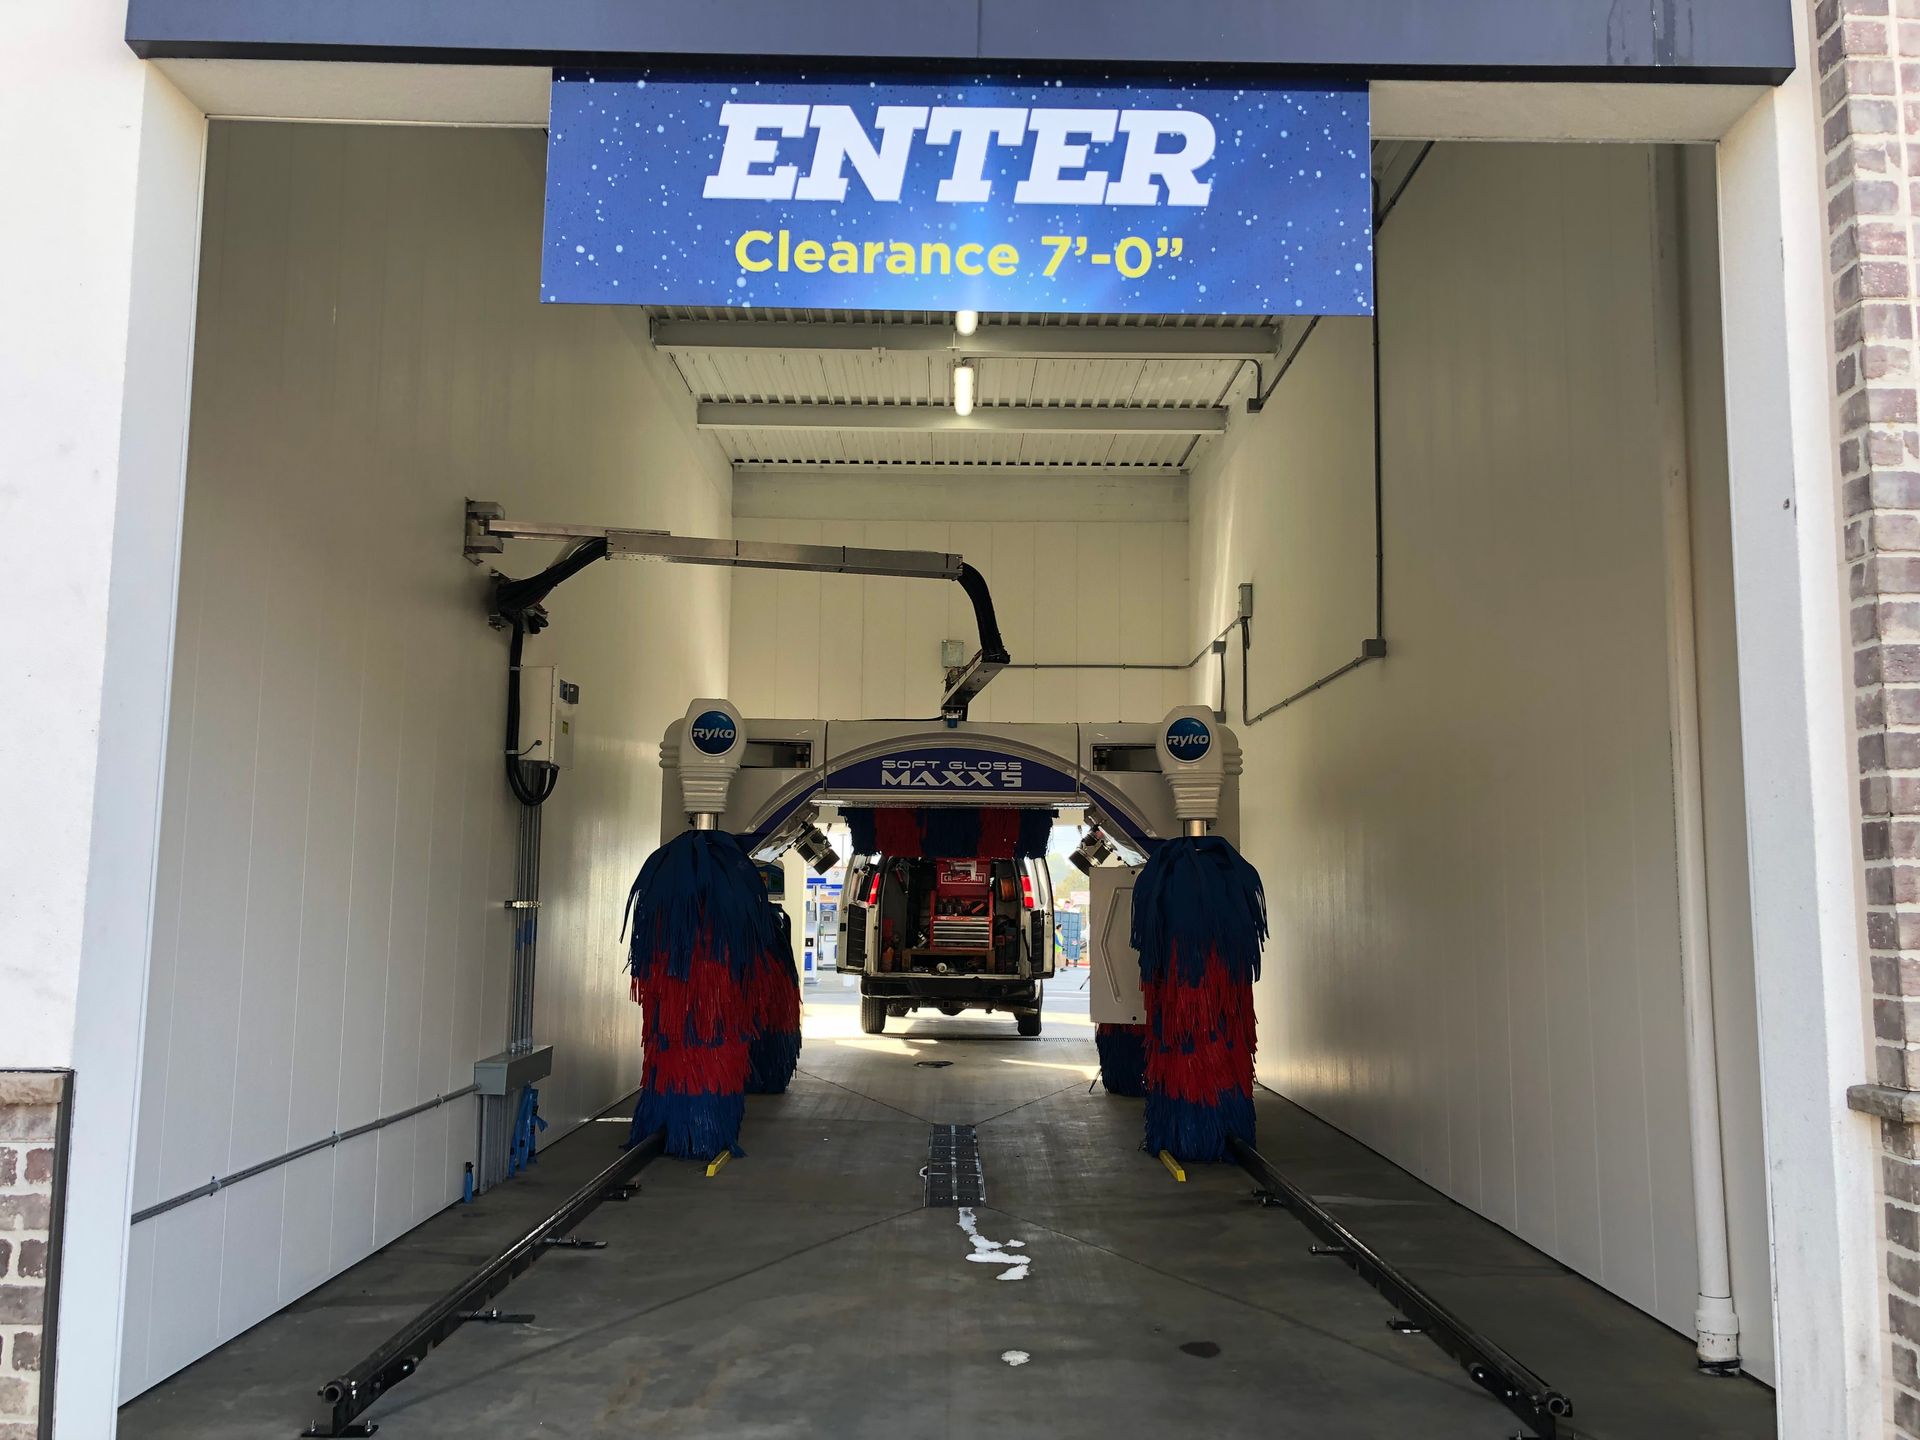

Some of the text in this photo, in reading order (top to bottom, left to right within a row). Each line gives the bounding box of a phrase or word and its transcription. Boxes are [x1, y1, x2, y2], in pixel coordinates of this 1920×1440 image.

[702, 102, 1216, 206] ENTER
[734, 229, 1018, 275] Clearance
[881, 760, 1022, 771] SOFT GLOSS
[881, 770, 1022, 787] MAXX 5
